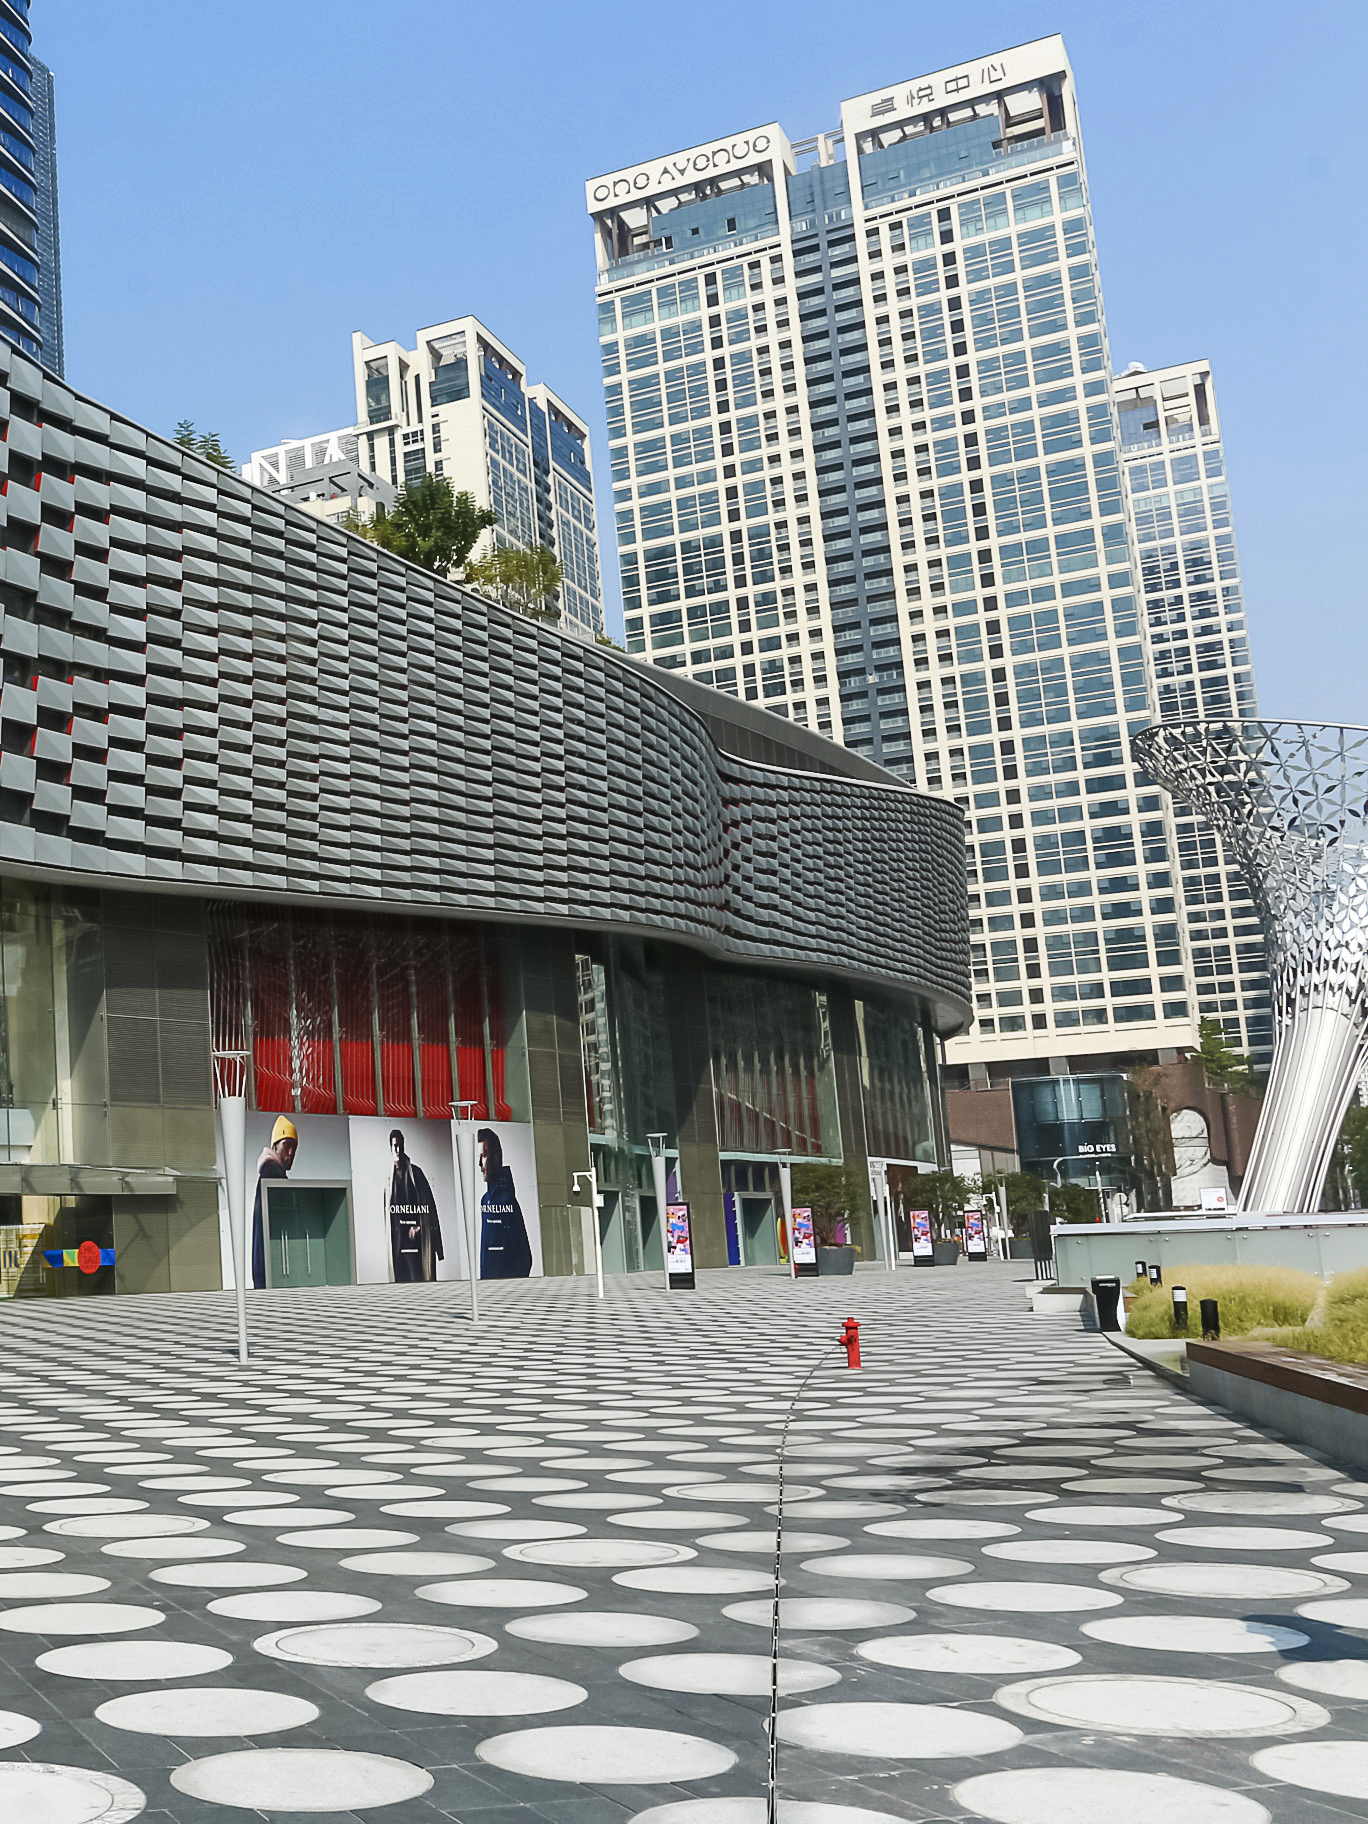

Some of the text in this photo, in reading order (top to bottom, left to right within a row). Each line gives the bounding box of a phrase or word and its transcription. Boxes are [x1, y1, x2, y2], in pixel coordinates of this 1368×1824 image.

[870, 62, 1007, 118] 卓悦中心
[1095, 1144, 1117, 1152] EYES
[388, 1204, 430, 1215] ORNELIANI
